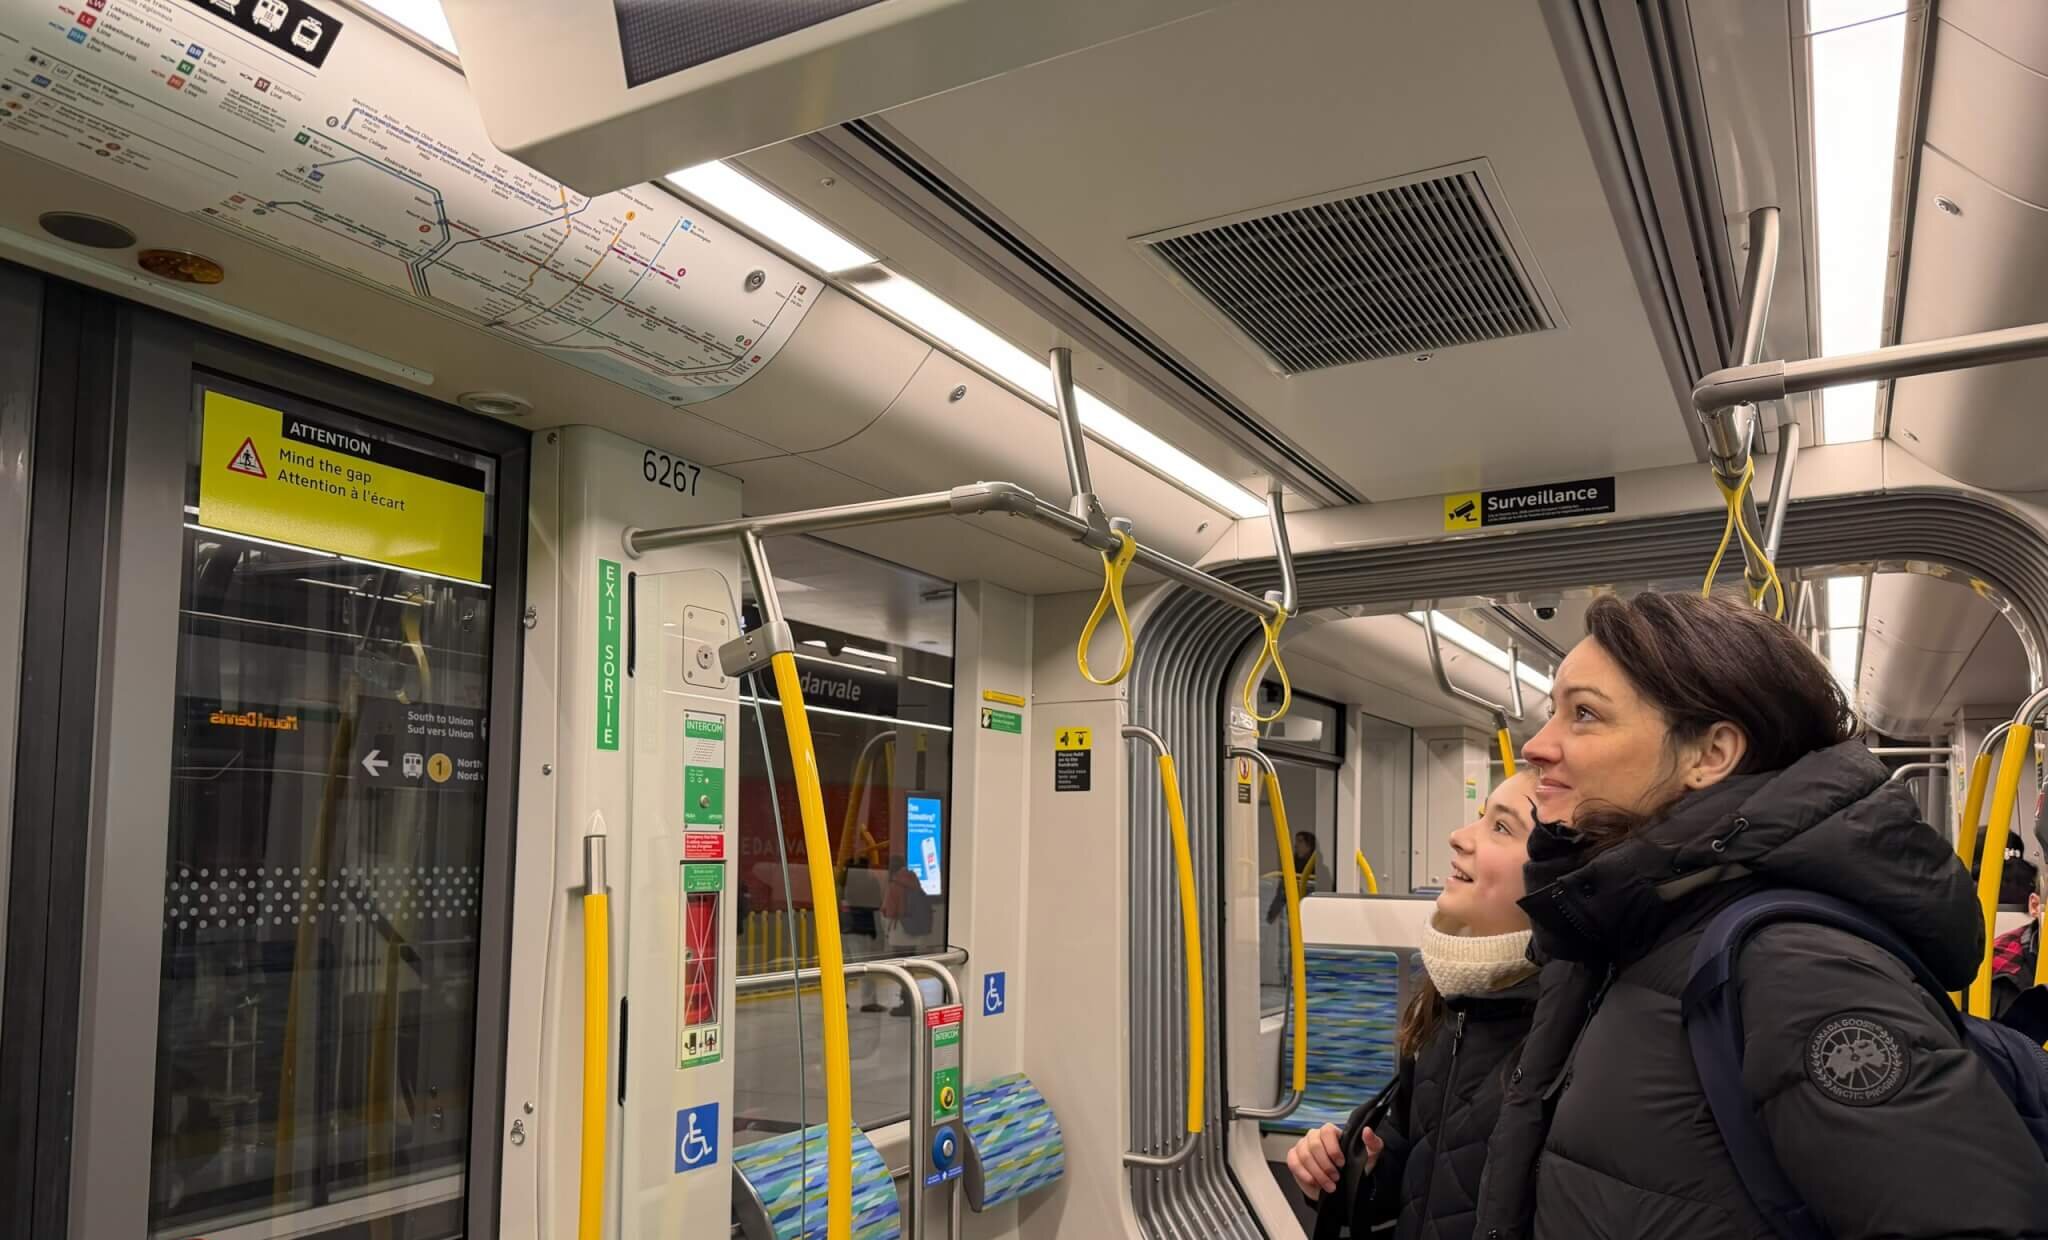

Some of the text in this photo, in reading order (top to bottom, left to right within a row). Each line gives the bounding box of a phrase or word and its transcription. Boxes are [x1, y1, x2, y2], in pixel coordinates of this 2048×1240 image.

[289, 419, 373, 457] ATTENTION
[279, 447, 373, 486] Mind the gap
[642, 448, 702, 497] 6267
[277, 469, 406, 512] Attention à l'écart
[1487, 487, 1599, 511] Surveillance
[602, 564, 616, 745] EXIT SORTIE
[800, 671, 862, 701] darvale
[406, 709, 475, 727] South to Union
[406, 723, 475, 739] Sud vers Union
[685, 720, 724, 734] INTERCOM
[456, 770, 479, 782] Nord
[1811, 1017, 1877, 1053] CANADA GOOSE
